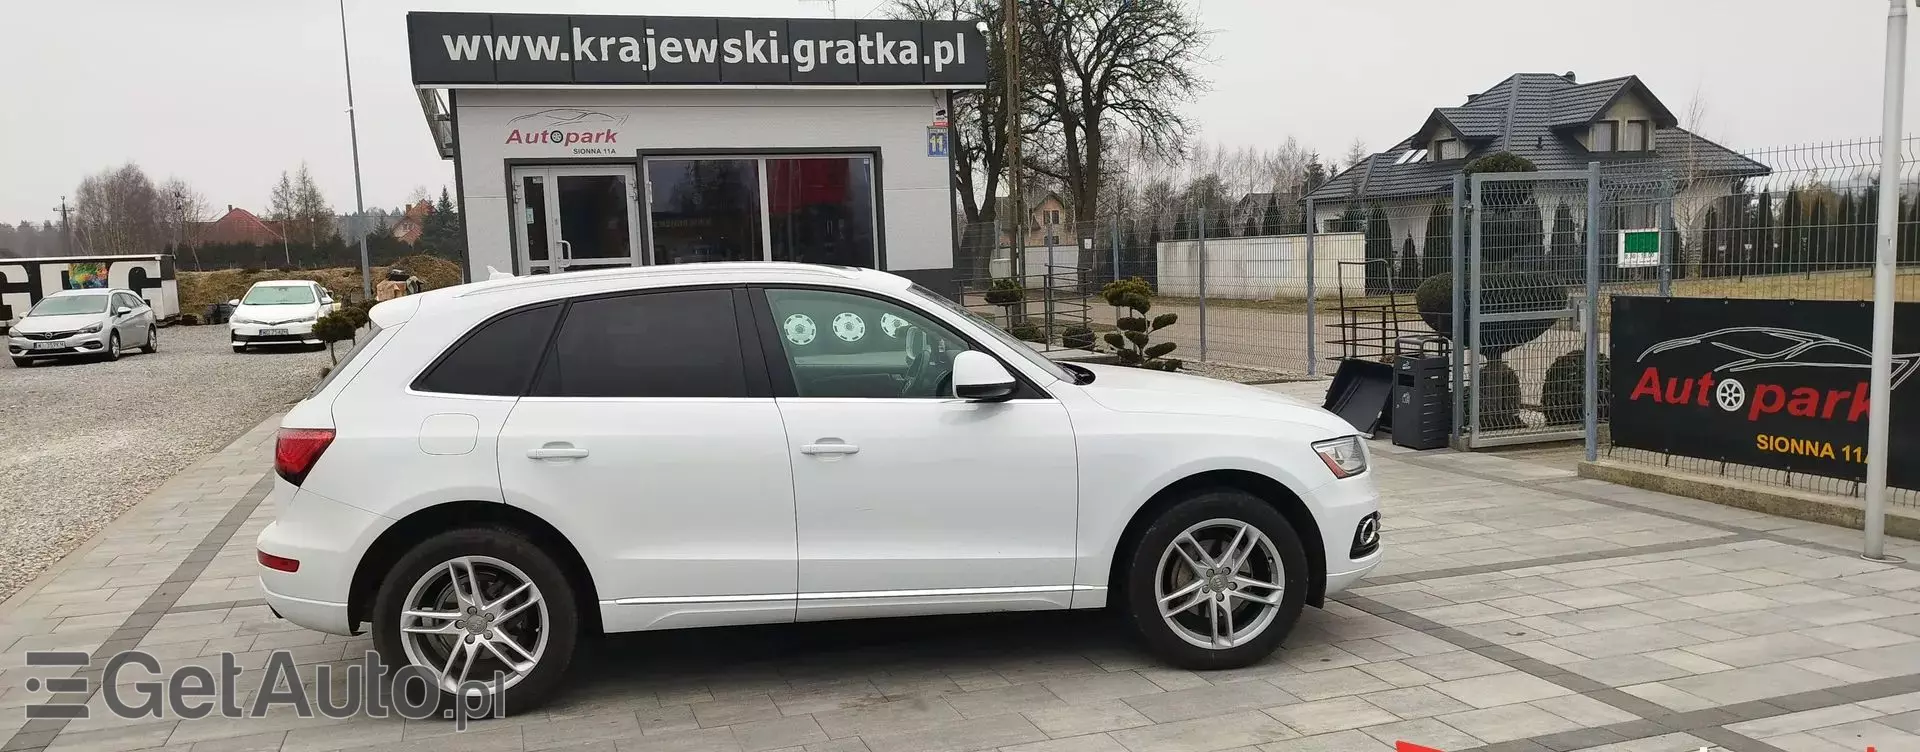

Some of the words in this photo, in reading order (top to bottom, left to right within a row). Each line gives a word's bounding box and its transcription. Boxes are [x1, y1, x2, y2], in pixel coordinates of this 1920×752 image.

[442, 27, 966, 72] www.krajewski.gratka.pl
[505, 129, 618, 146] Autopark
[929, 135, 943, 152] 11
[1756, 433, 1836, 460] SIONNA
[1841, 444, 1869, 464] 11
